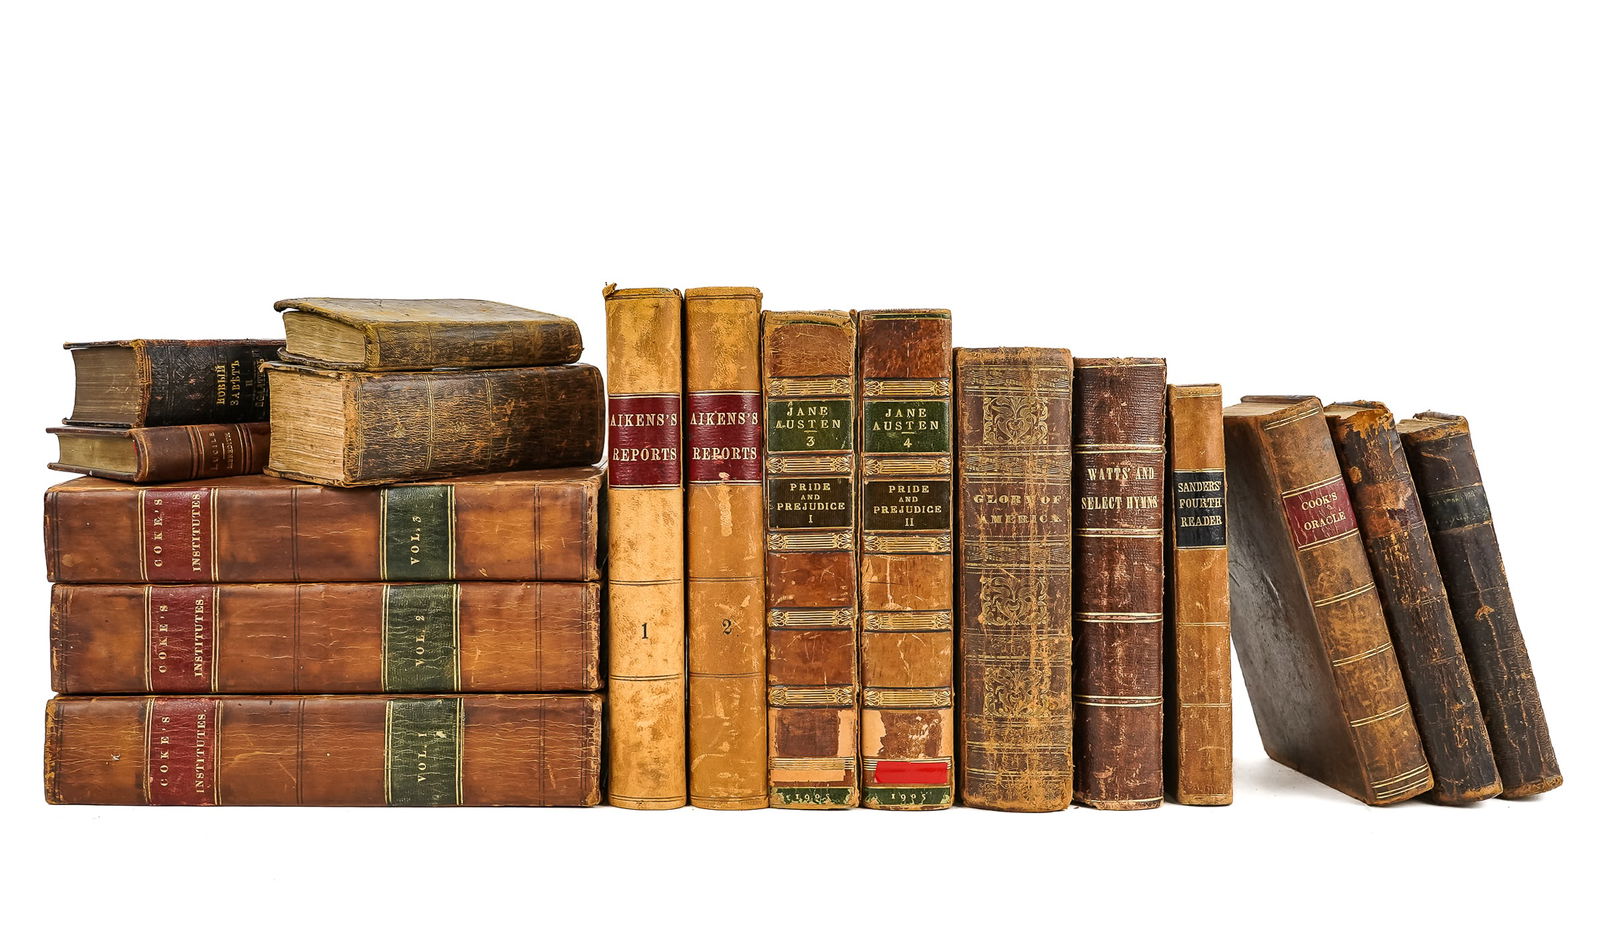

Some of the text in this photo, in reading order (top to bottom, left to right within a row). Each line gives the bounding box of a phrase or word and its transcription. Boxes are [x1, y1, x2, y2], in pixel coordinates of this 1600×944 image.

[214, 364, 226, 405] НОВЫЙ
[786, 406, 829, 417] JANE
[885, 408, 927, 418] JANE
[610, 413, 678, 427] AIKENS'S
[690, 412, 759, 426] AIKENS'S
[775, 419, 841, 429] AUSTEN
[872, 420, 940, 431] AUSTEN
[806, 435, 816, 447] 3
[903, 437, 913, 448] 4
[612, 447, 678, 462] REPORTS
[692, 446, 758, 461] REPORTS
[1135, 466, 1155, 480] AND
[789, 482, 831, 492] PRIDE
[888, 485, 930, 494] PRIDE
[800, 493, 821, 501] AND
[973, 494, 1062, 505] GLORY OF
[1081, 495, 1158, 510] SELECT HYMNS
[1179, 497, 1223, 508] FOURTH
[1301, 491, 1338, 511] COOK'S
[776, 502, 846, 511] PREJUDICE
[873, 504, 942, 514] PREJUDICE
[412, 515, 422, 523] 3
[808, 514, 814, 524] I
[904, 517, 914, 527] II
[976, 514, 1063, 524] AMERICA
[1180, 515, 1223, 527] READER
[1304, 510, 1346, 531] ORACLE
[153, 498, 163, 568] COKE'S
[191, 493, 202, 572] INSTITUTES
[641, 622, 648, 640] 1
[721, 618, 732, 635] 2
[158, 605, 168, 674] COKE'S
[160, 716, 170, 787] COKE'S
[417, 744, 428, 783] VOL.
[890, 792, 927, 802] 1905
